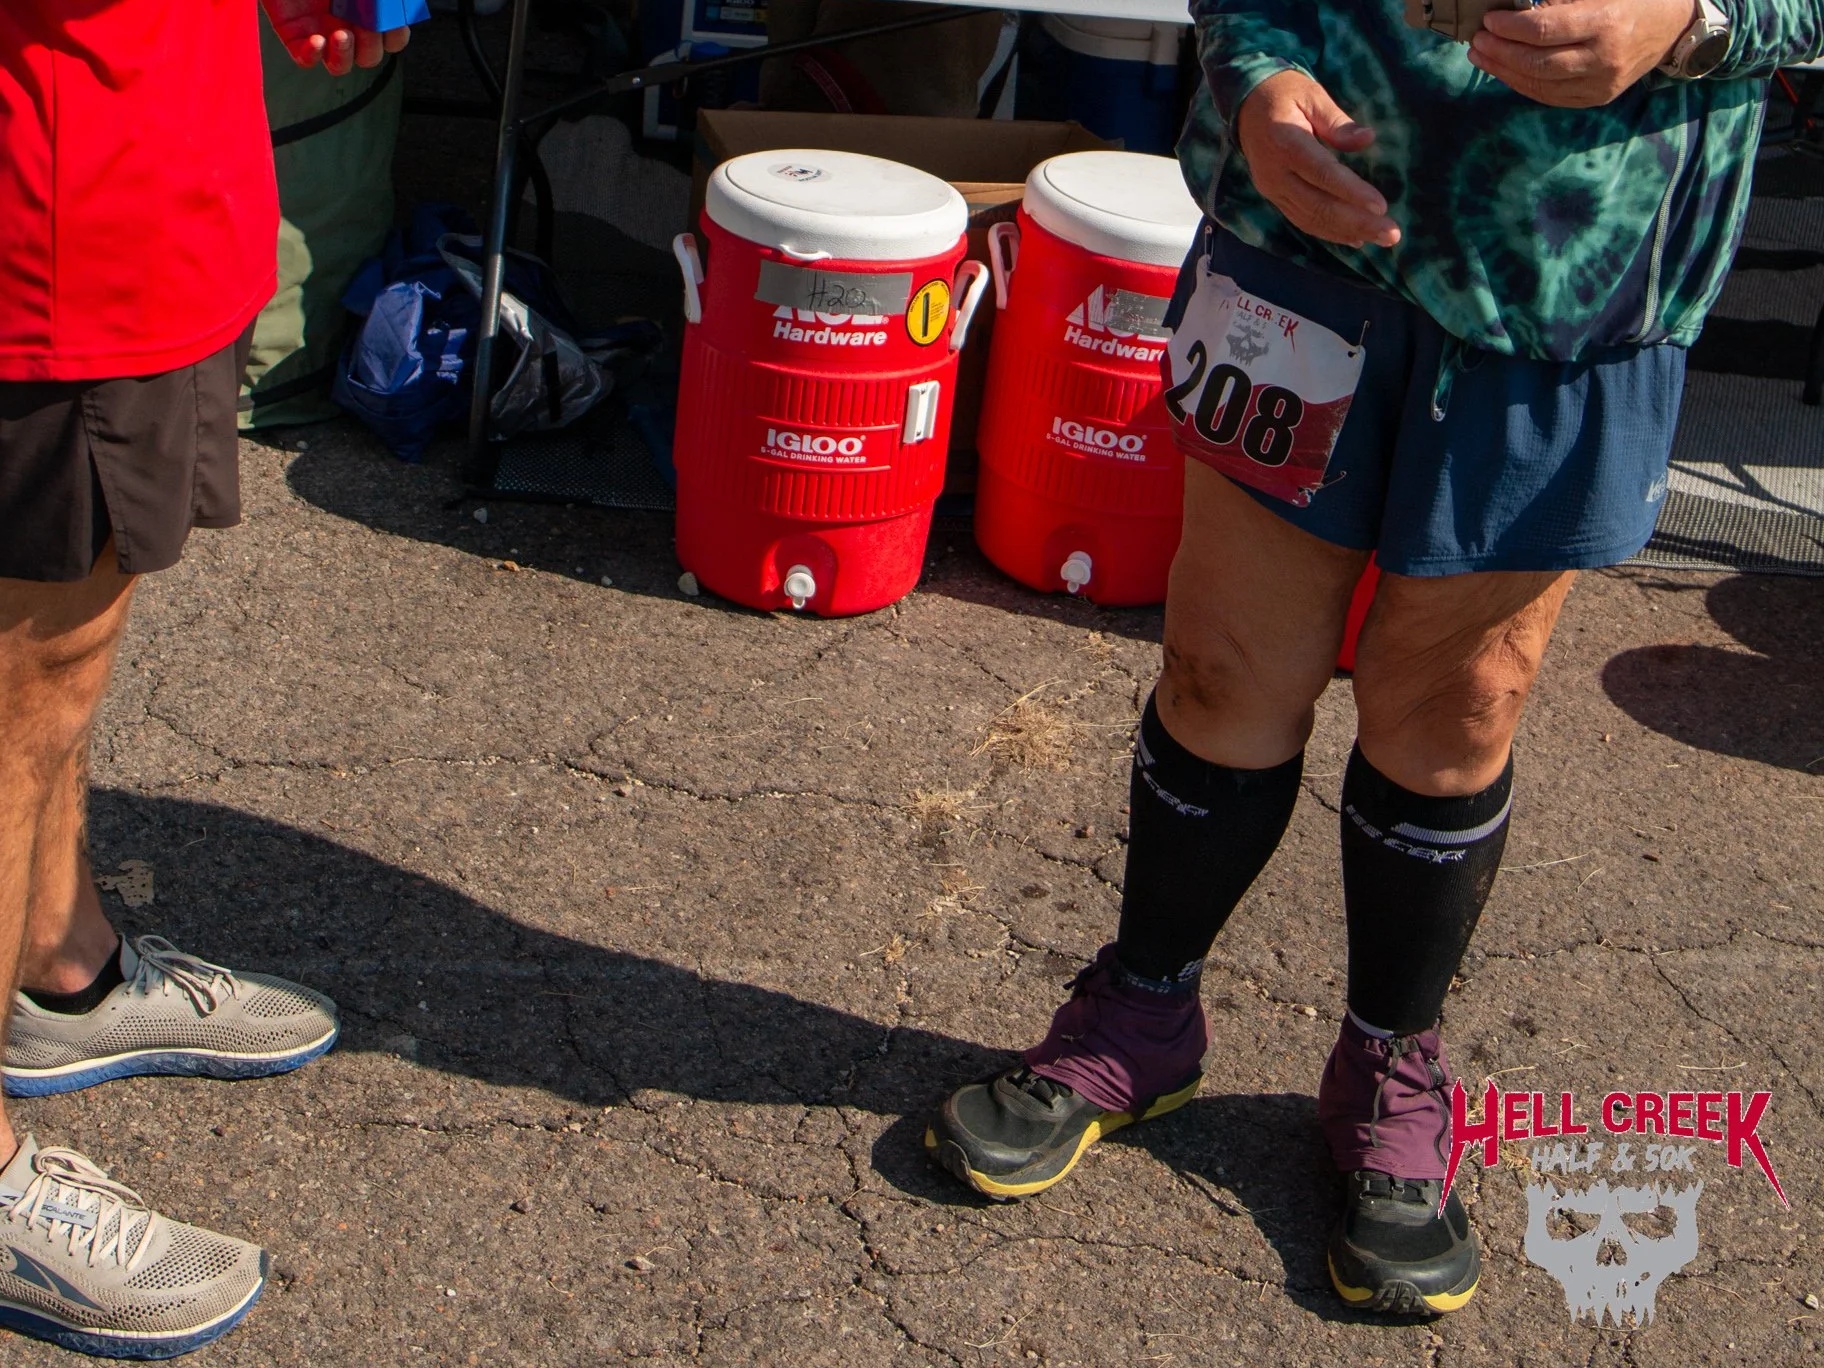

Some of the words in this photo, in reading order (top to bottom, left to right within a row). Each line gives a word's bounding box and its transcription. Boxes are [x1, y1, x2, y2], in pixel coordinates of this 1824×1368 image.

[773, 320, 888, 347] Hardware
[1164, 339, 1305, 468] 208
[766, 428, 863, 456] IGLOO
[1052, 416, 1144, 453] IGLOO
[790, 452, 834, 464] DRINKING
[836, 456, 867, 465] WATER
[1073, 442, 1115, 458] DRINKING
[1115, 451, 1147, 463] WATER
